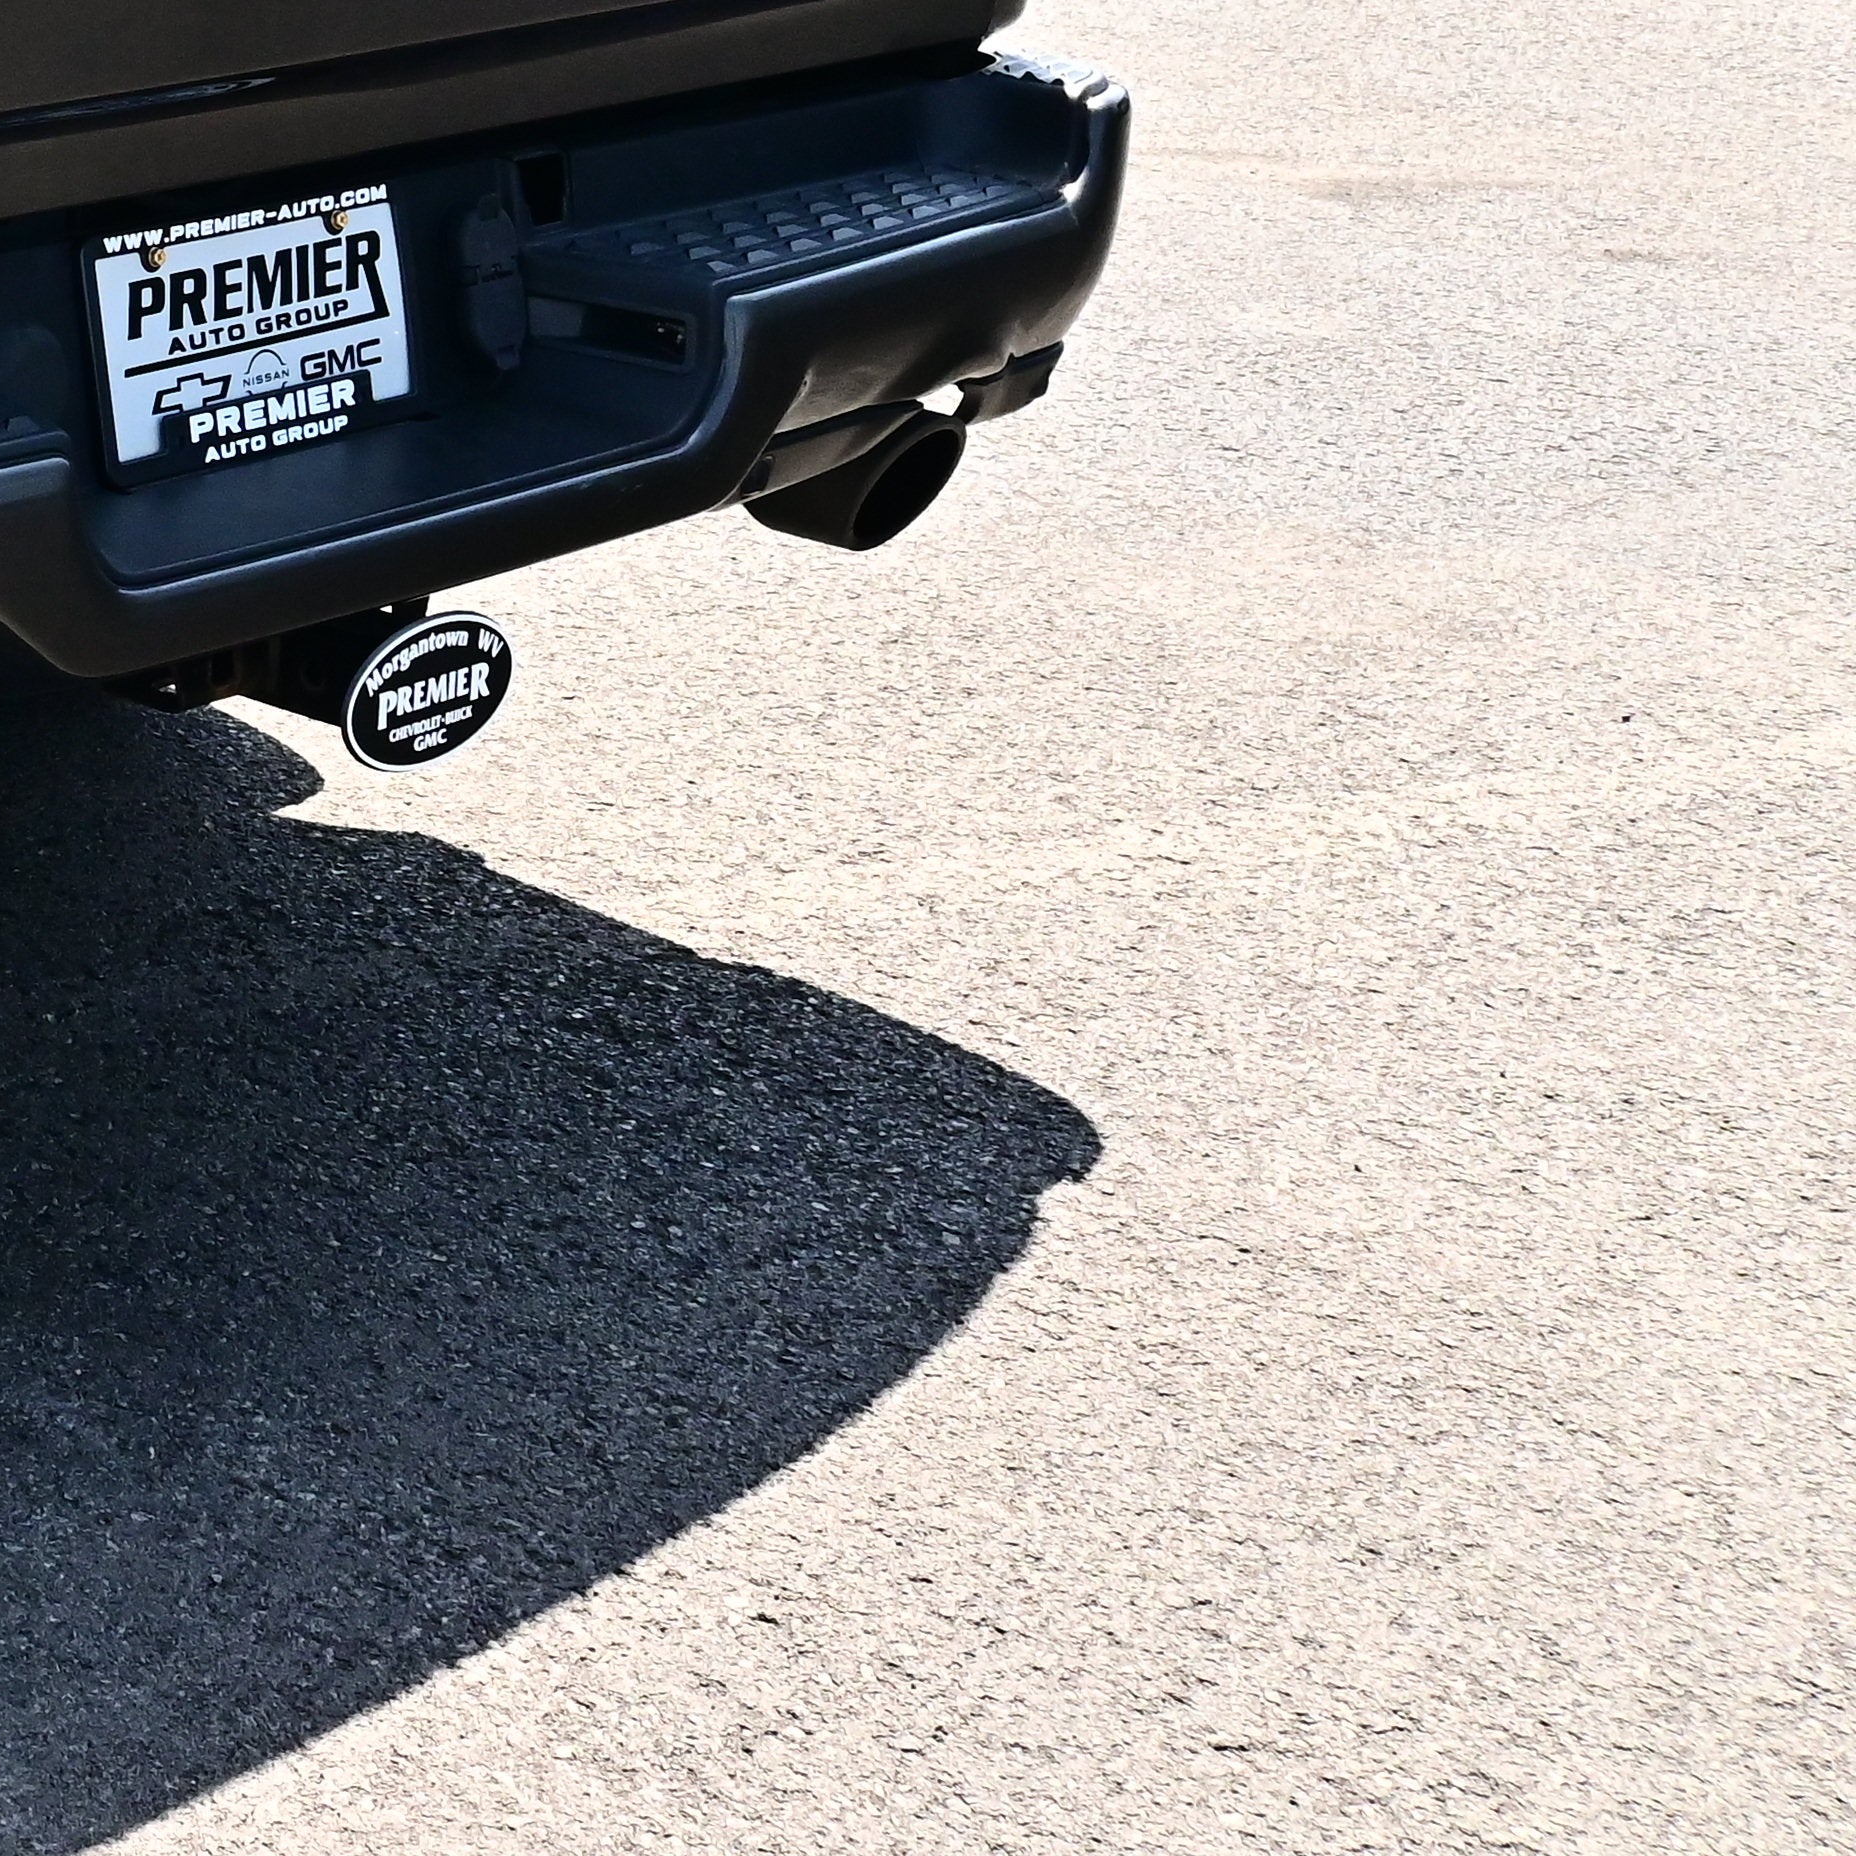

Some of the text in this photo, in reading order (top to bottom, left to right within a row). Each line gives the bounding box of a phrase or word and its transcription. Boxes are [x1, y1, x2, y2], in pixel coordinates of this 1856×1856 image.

[103, 184, 387, 254] WWW.PREMIER-AUTO.COM
[127, 230, 390, 341] PREMIER
[168, 299, 350, 356] AUTO GROUP
[242, 368, 290, 388] NISSAN
[300, 338, 383, 381] GMC
[189, 379, 356, 444] PREMIER
[205, 414, 349, 464] AUTO GROUP
[365, 628, 504, 697] Morgantown WV
[377, 662, 490, 731] PREMIER
[413, 728, 448, 752] GMC
